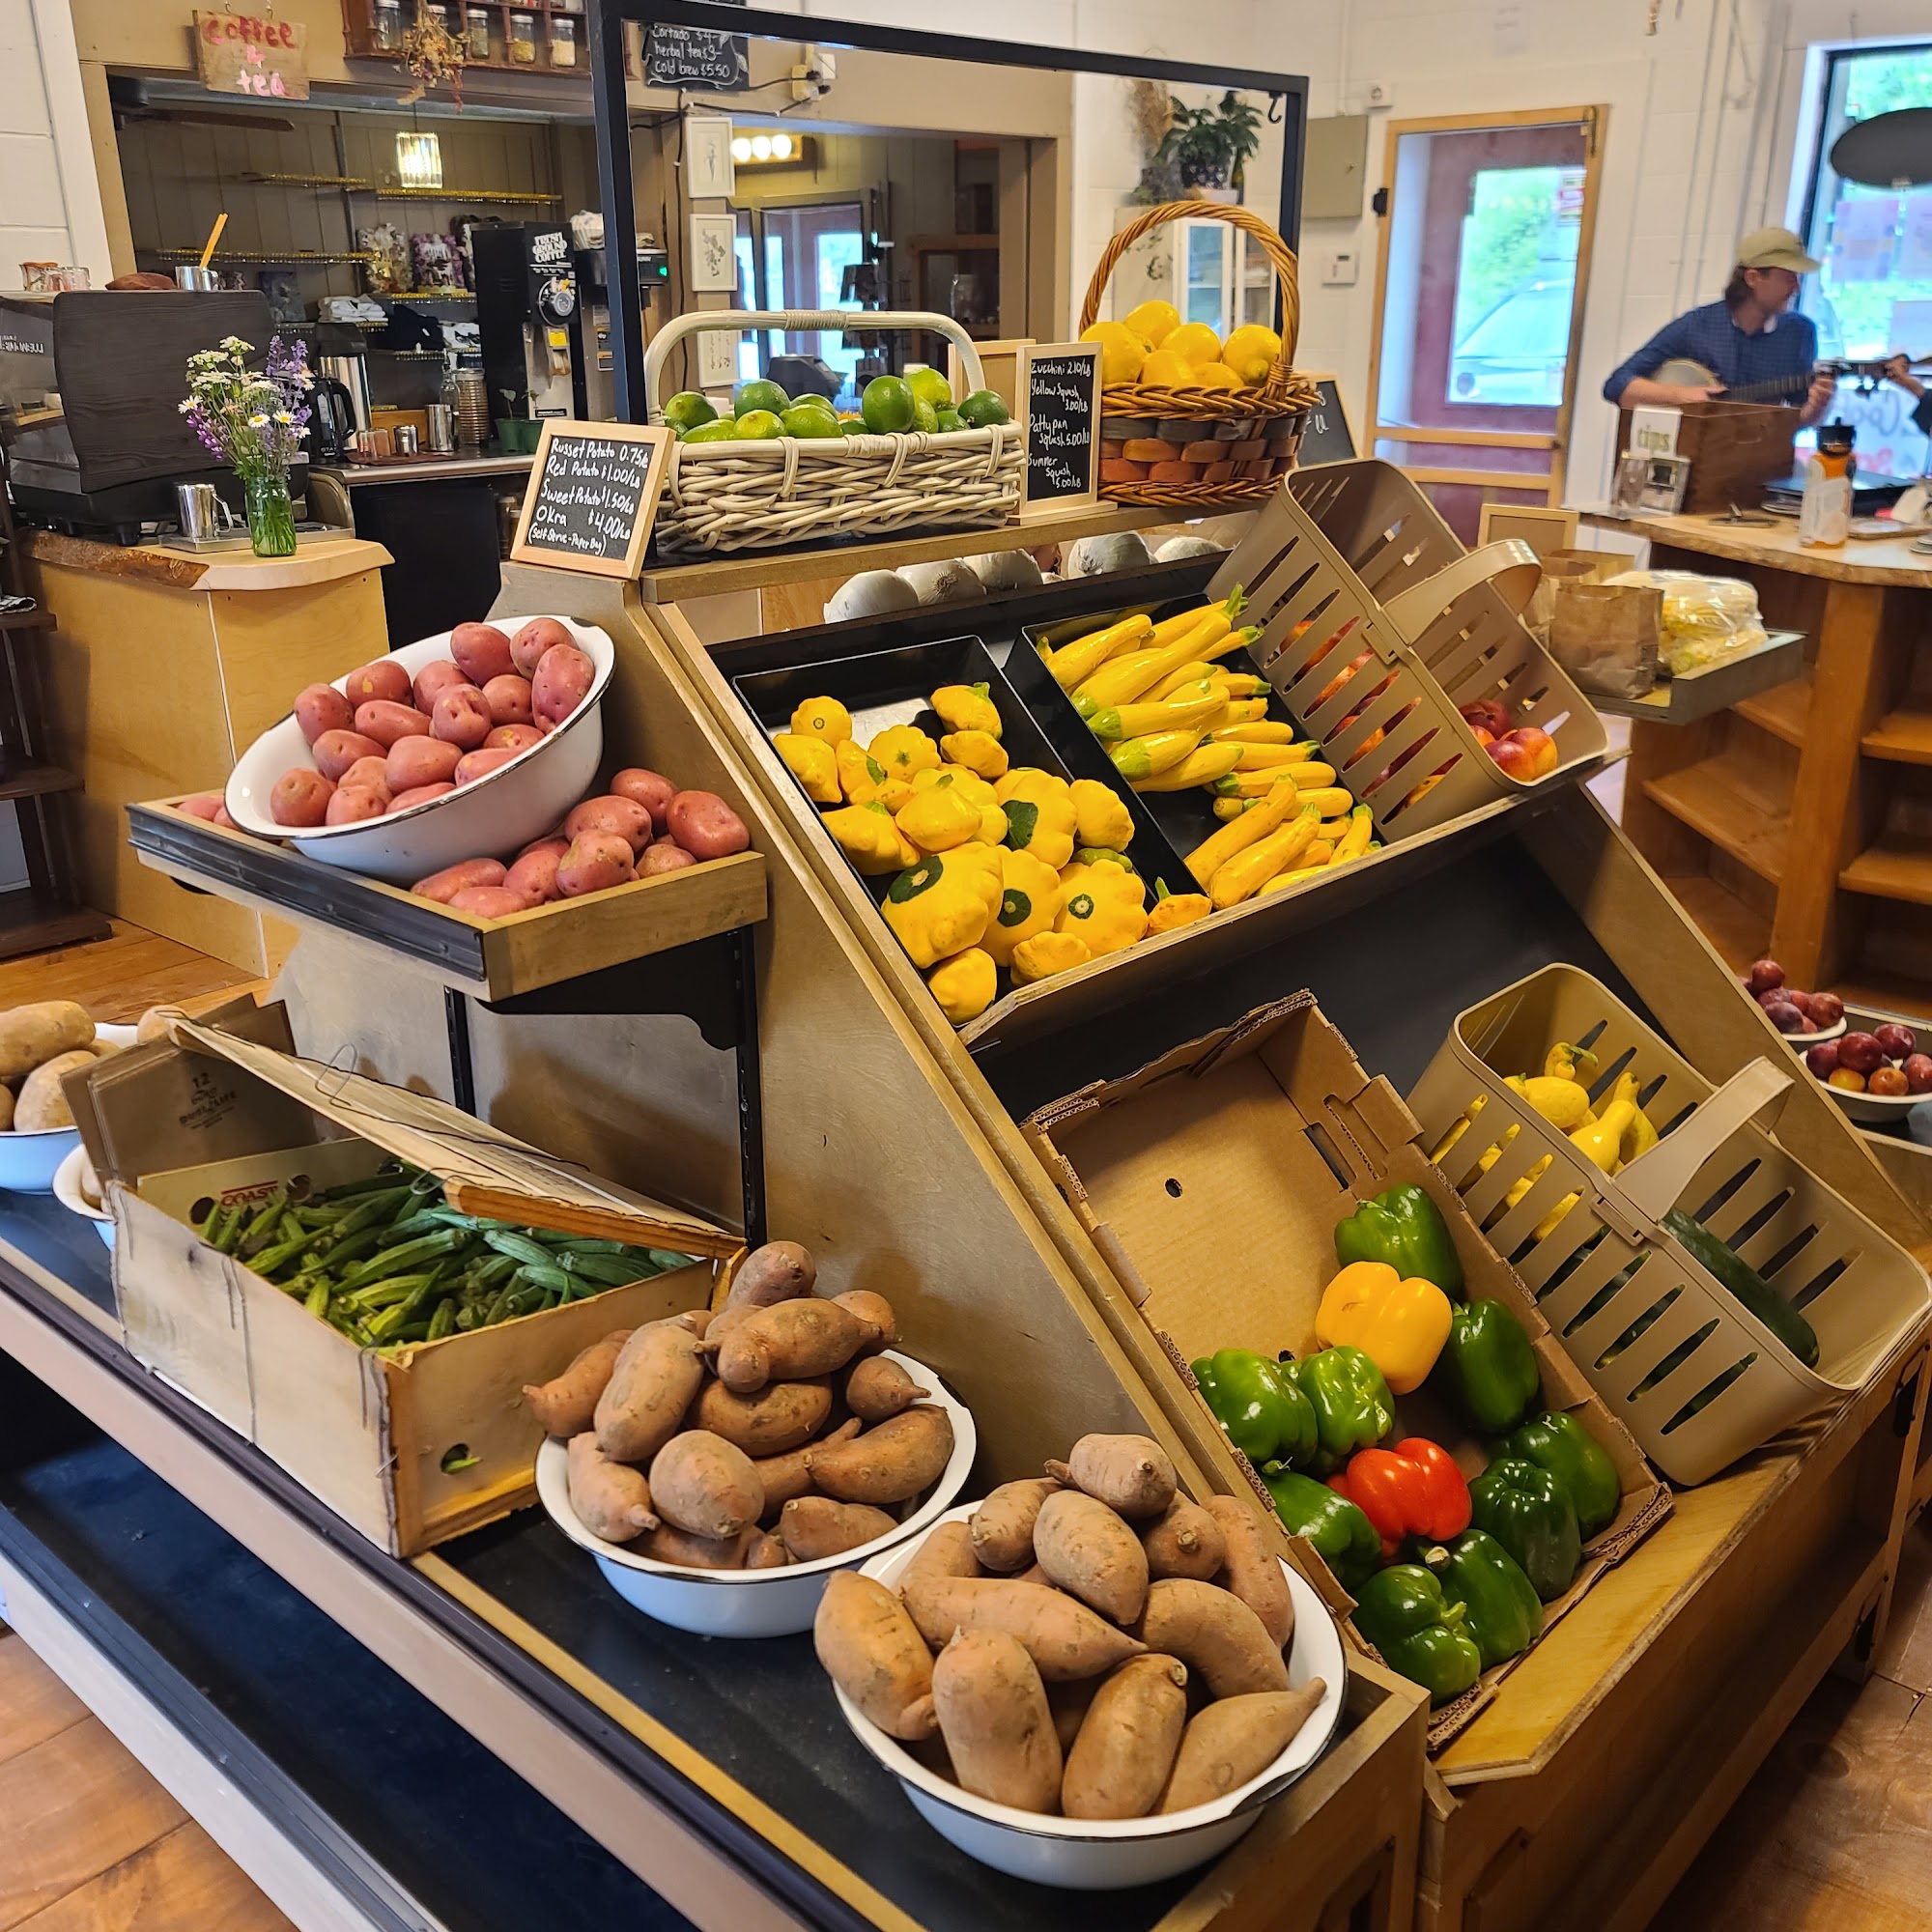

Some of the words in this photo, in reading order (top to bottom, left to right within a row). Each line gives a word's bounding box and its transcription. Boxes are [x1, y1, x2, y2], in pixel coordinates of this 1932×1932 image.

[654, 41, 685, 60] herbal
[655, 59, 676, 75] cold
[236, 69, 294, 98] tea
[535, 249, 567, 263] COFFEE
[1031, 360, 1065, 376] Zucchini
[1031, 378, 1057, 397] Yellow
[551, 438, 585, 459] Russet
[586, 440, 615, 458] Potato
[547, 455, 567, 476] Red
[571, 460, 600, 477] Potato
[541, 478, 575, 505] Sweet
[575, 486, 601, 506] Potato
[192, 1071, 212, 1089] 12
